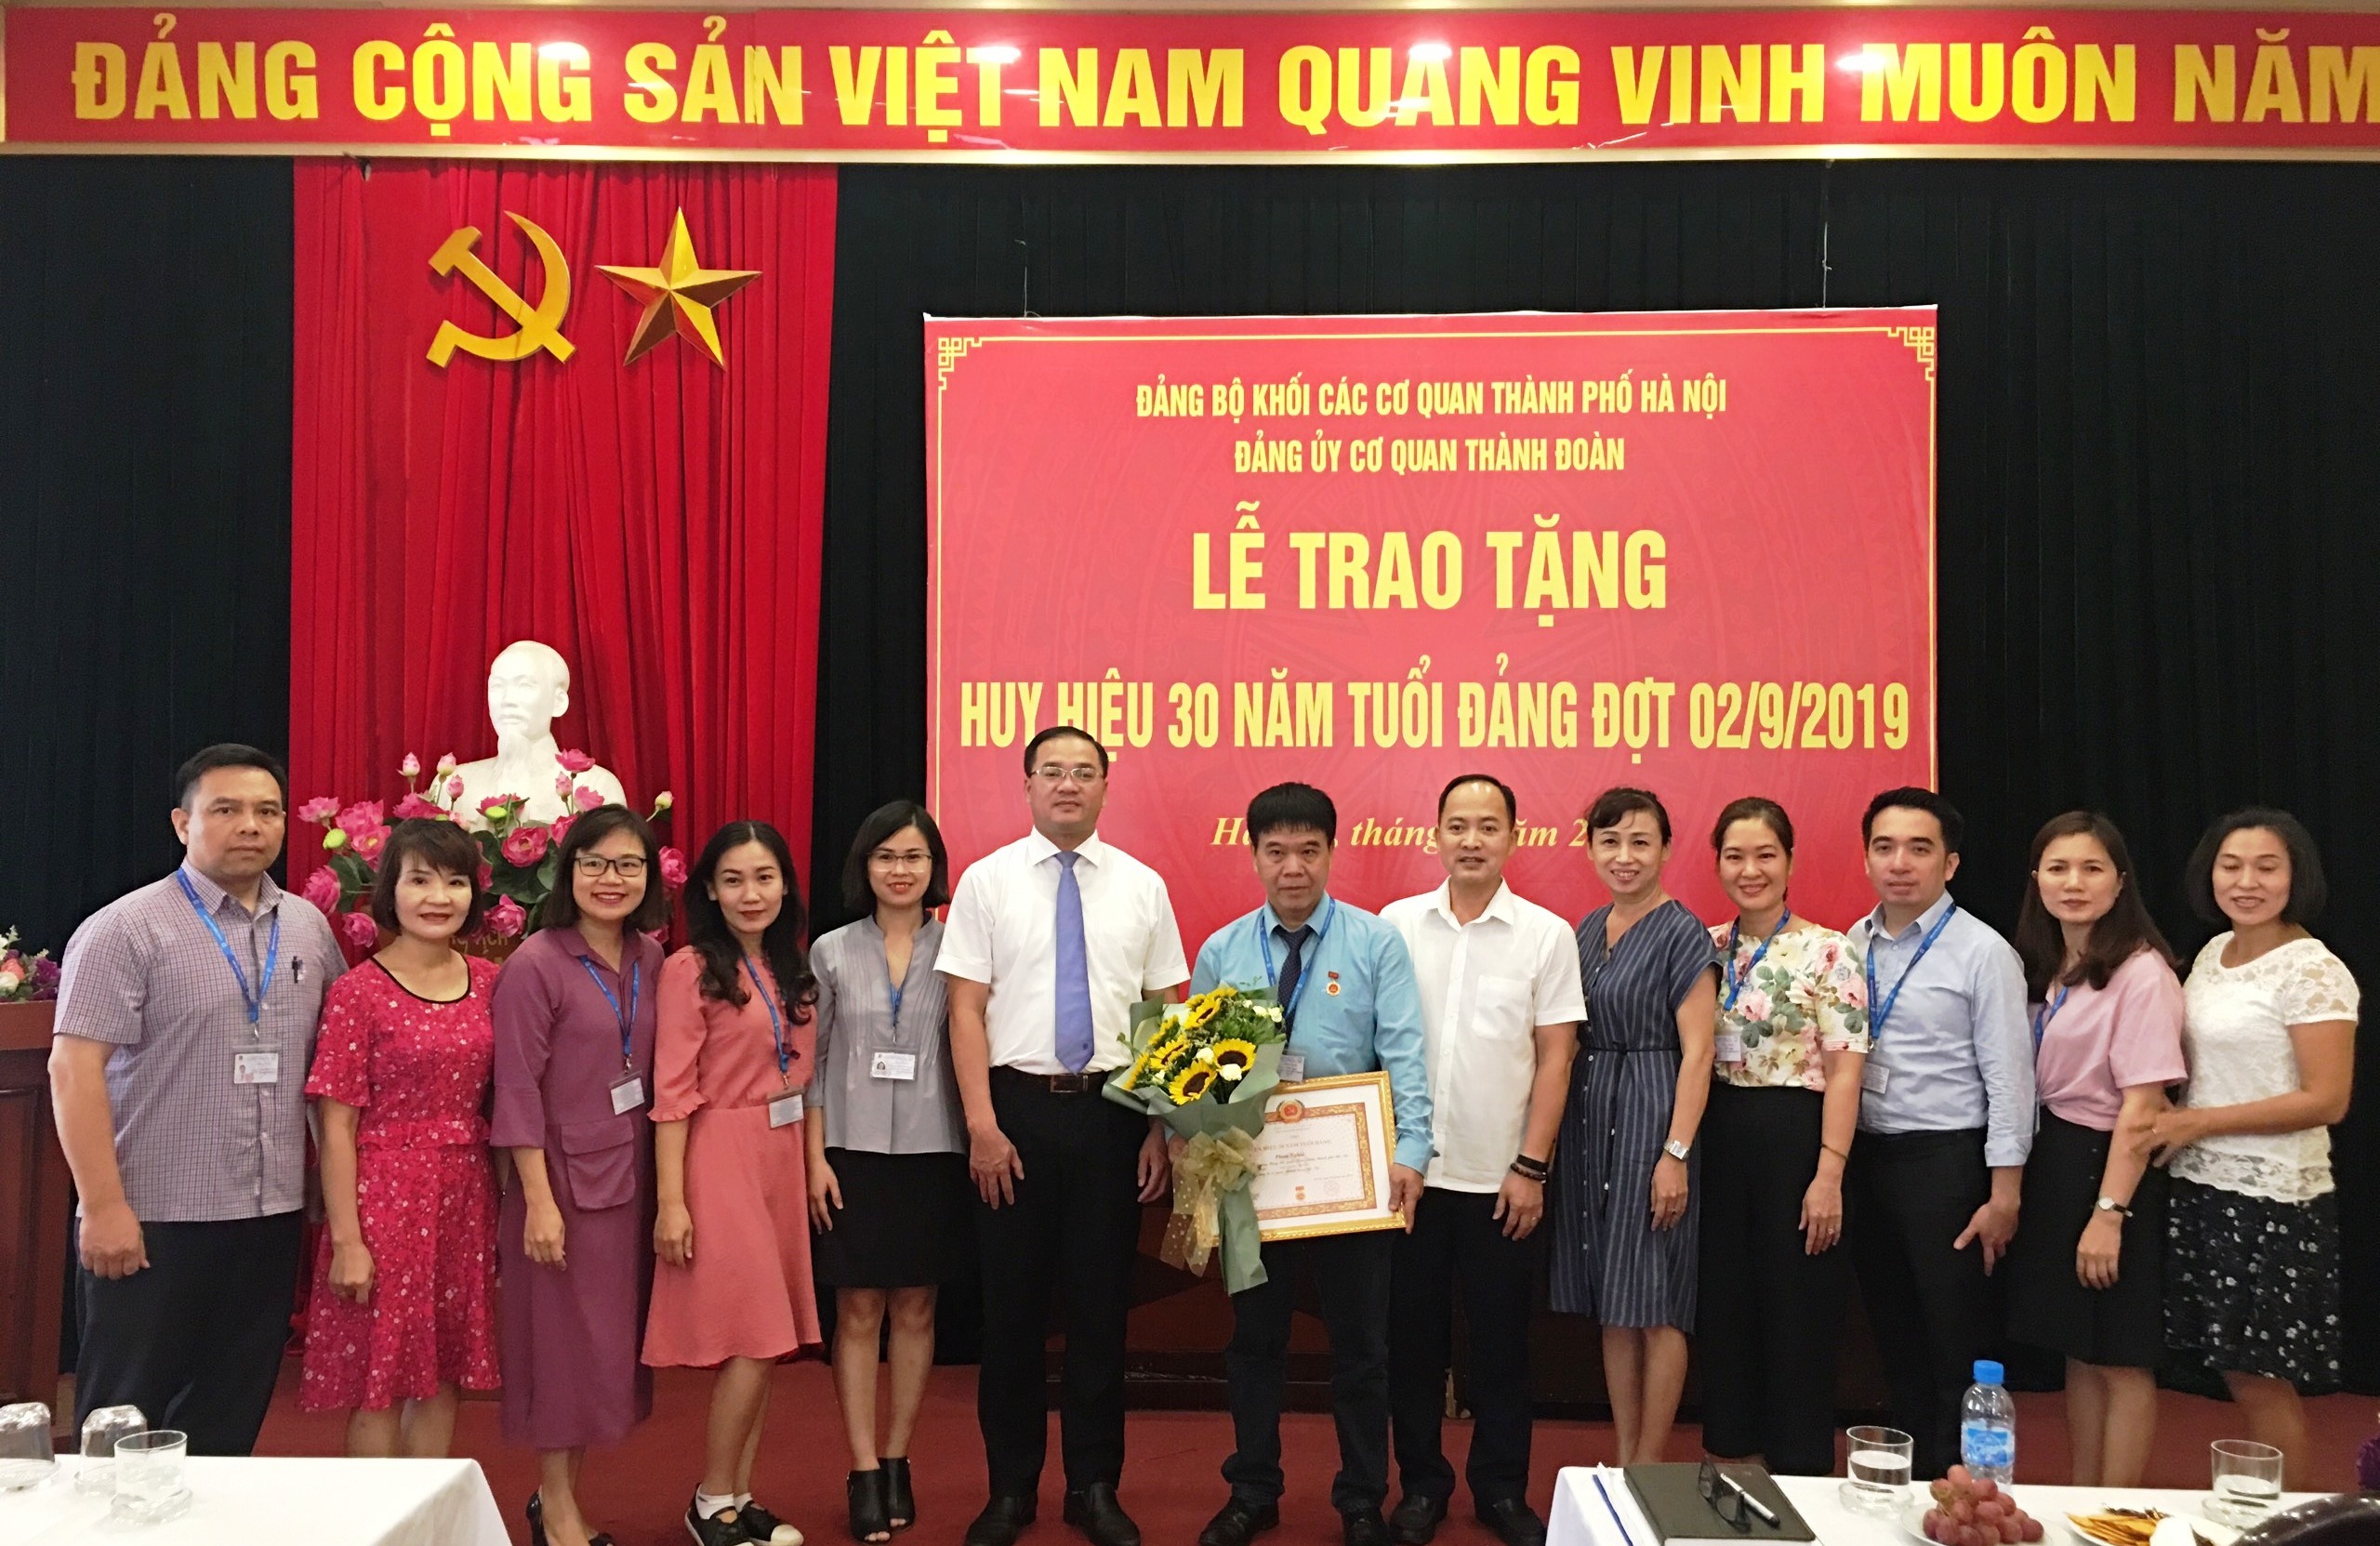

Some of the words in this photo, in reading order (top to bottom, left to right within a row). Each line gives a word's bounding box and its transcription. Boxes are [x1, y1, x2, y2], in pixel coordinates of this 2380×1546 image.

[72, 14, 319, 121] ĐẢNG
[352, 23, 592, 136] CỘNG
[623, 15, 804, 126] SẢN
[828, 30, 1012, 142] VIỆT
[1038, 48, 1244, 127] NAM
[1278, 45, 1580, 135] QUANG
[1610, 44, 1826, 125] VINH
[1860, 26, 2136, 123] MUÔN
[2174, 28, 2380, 124] NĂM
[1136, 374, 1204, 416] ĐẢNG
[1211, 377, 1245, 423] BỘ
[1252, 372, 1310, 416] KHỐI
[1318, 375, 1368, 416] CÁC
[1376, 377, 1410, 415] CƠ
[1417, 381, 1484, 418] QUAN
[1490, 373, 1574, 414] THÀNH
[1582, 368, 1633, 413] PHỐ
[1641, 373, 1675, 412] HÀ
[1682, 372, 1726, 419] NỘI
[1235, 429, 1302, 472] ĐẢNG
[1311, 429, 1342, 472] ỦY
[1350, 436, 1383, 472] CƠ
[1391, 439, 1457, 475] QUAN
[1465, 431, 1547, 470] THÀNH
[1554, 430, 1625, 470] ĐOÀN
[1193, 500, 1266, 609] LỄ
[1289, 531, 1462, 609] TRAO
[1486, 513, 1666, 627] TẶNG
[961, 681, 1043, 747] HUY
[1058, 667, 1154, 762] HIỆU
[1168, 681, 1219, 747] 30
[1234, 667, 1333, 747] NĂM
[1348, 654, 1443, 747] TUỔI
[1458, 652, 1578, 748] ĐẢNG
[1592, 677, 1675, 764] ĐỢT
[1689, 681, 1909, 749] 02/9/2019
[1351, 817, 1438, 854] tháng
